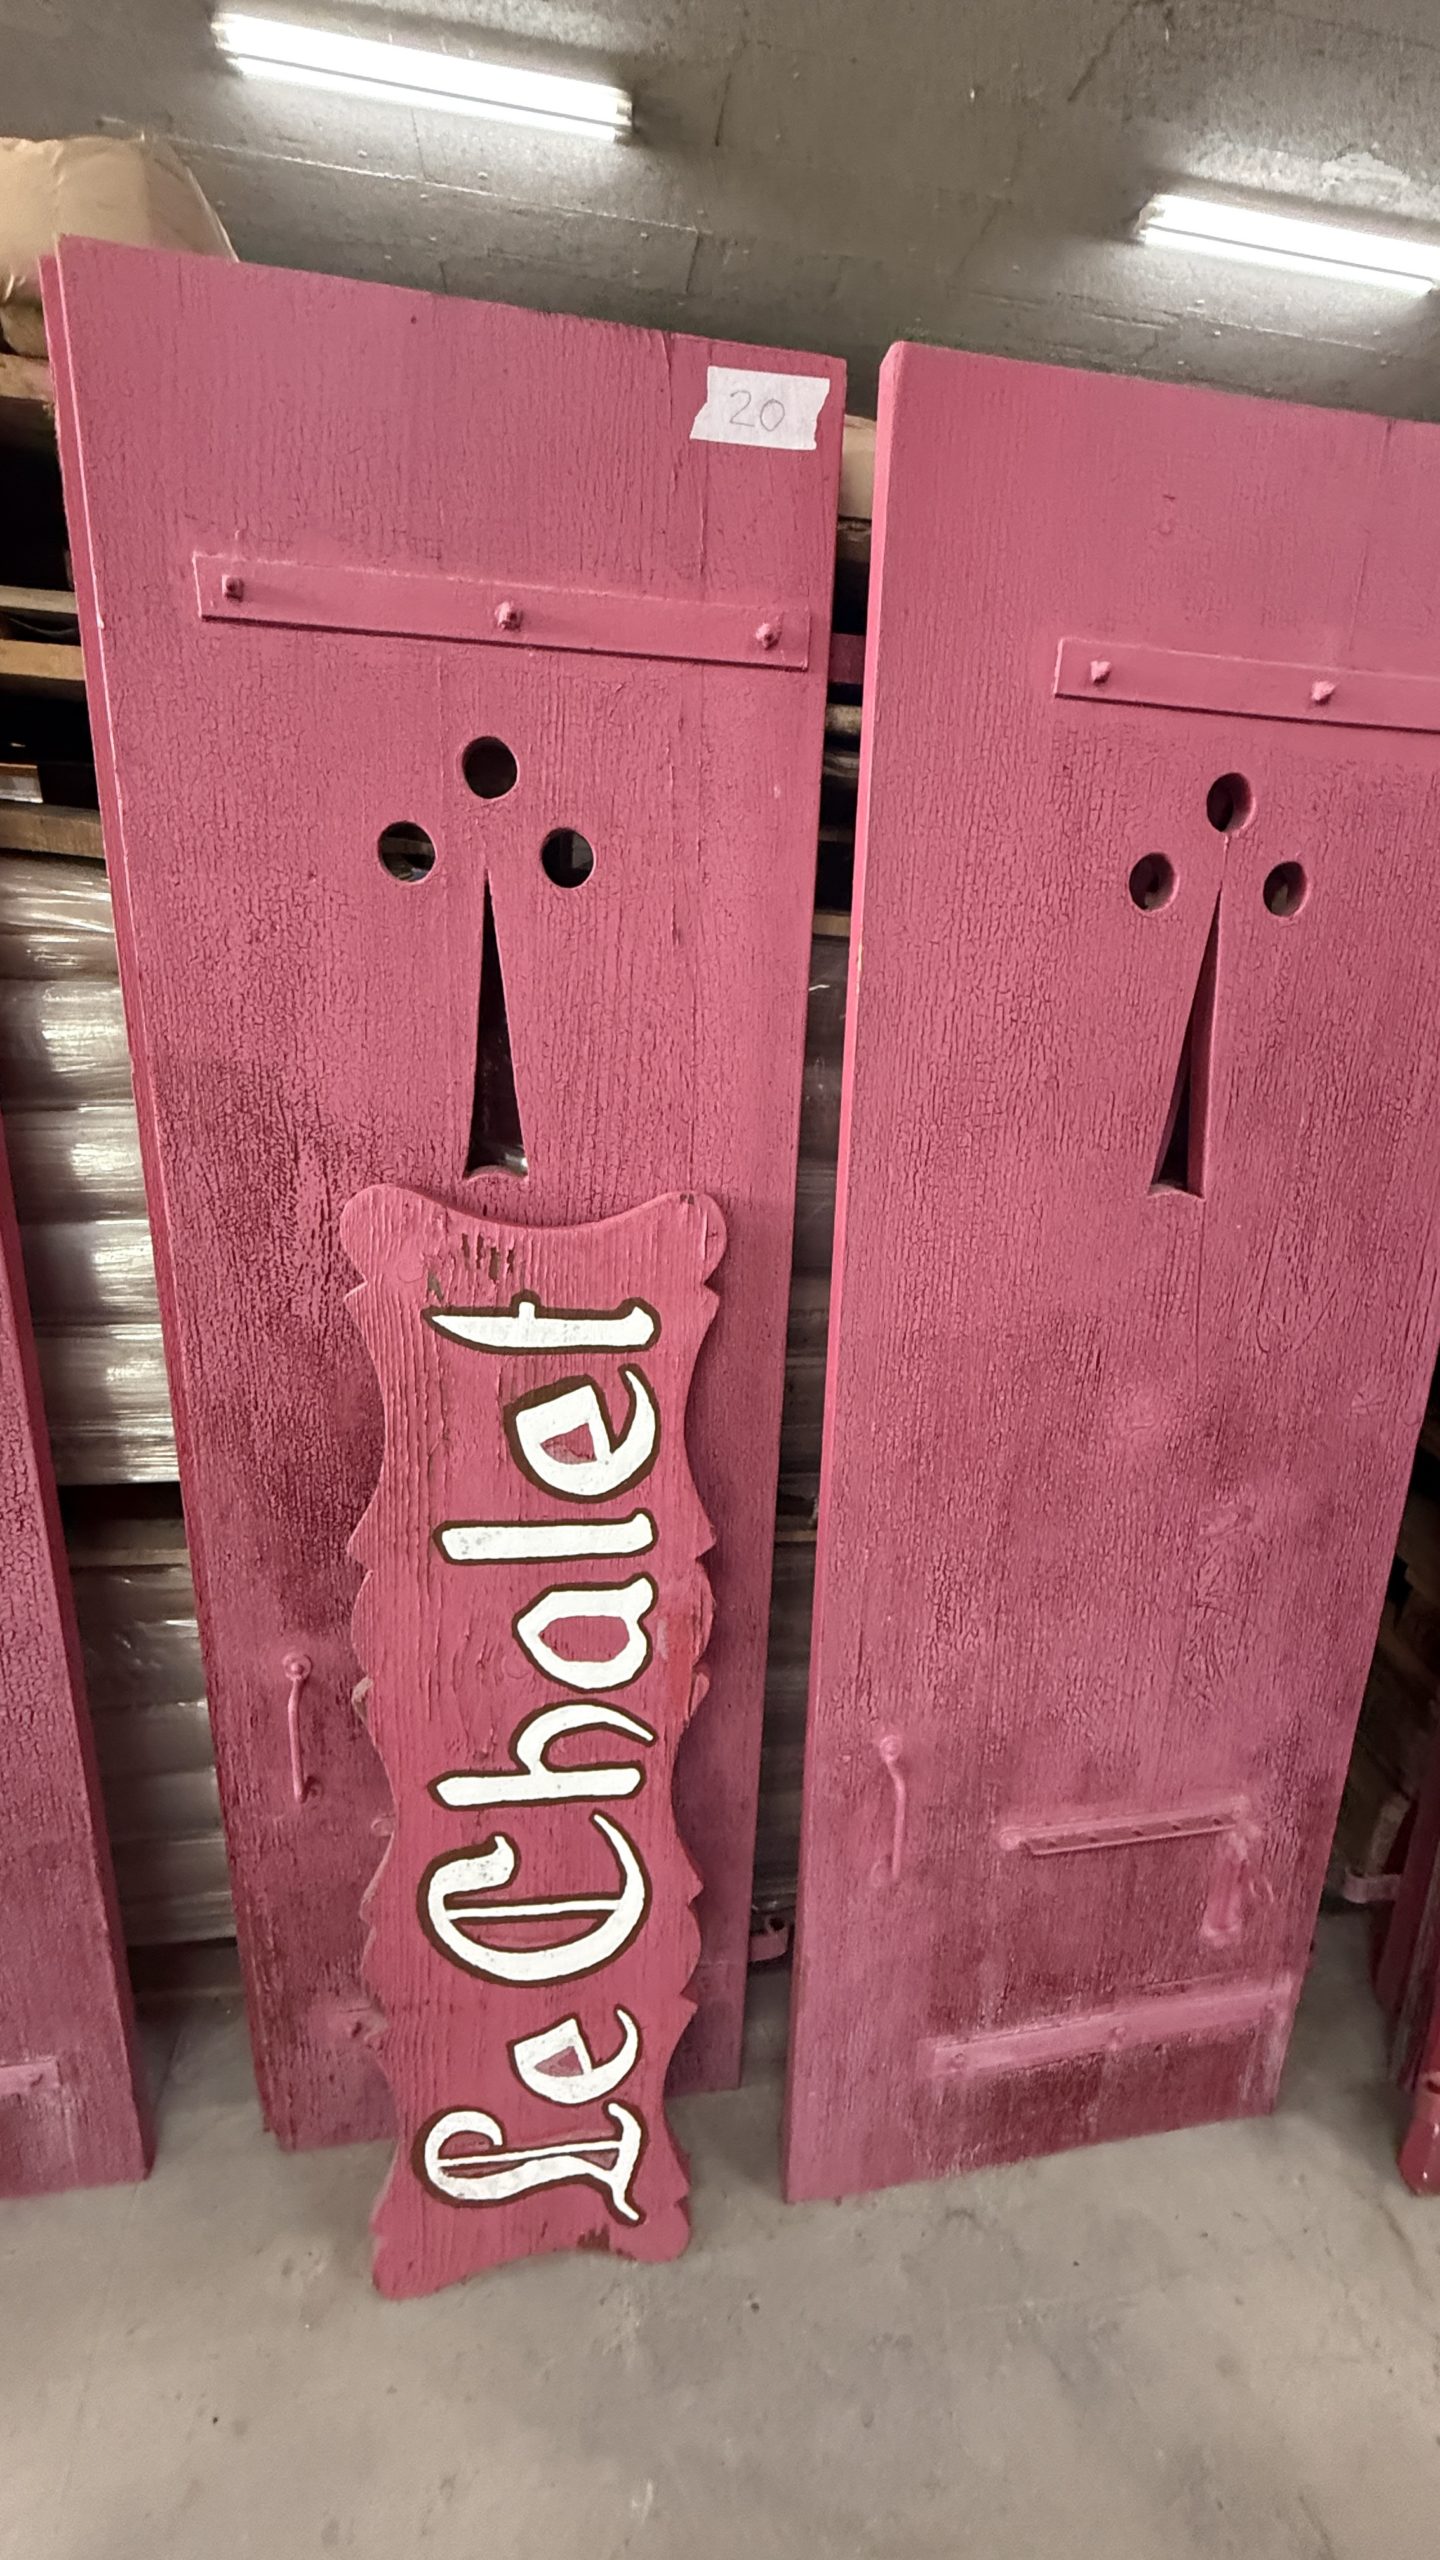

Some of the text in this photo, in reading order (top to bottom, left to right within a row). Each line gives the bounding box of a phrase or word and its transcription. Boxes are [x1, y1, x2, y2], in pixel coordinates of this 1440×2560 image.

[729, 390, 785, 432] 20
[411, 1289, 662, 2227] Le Chalet
